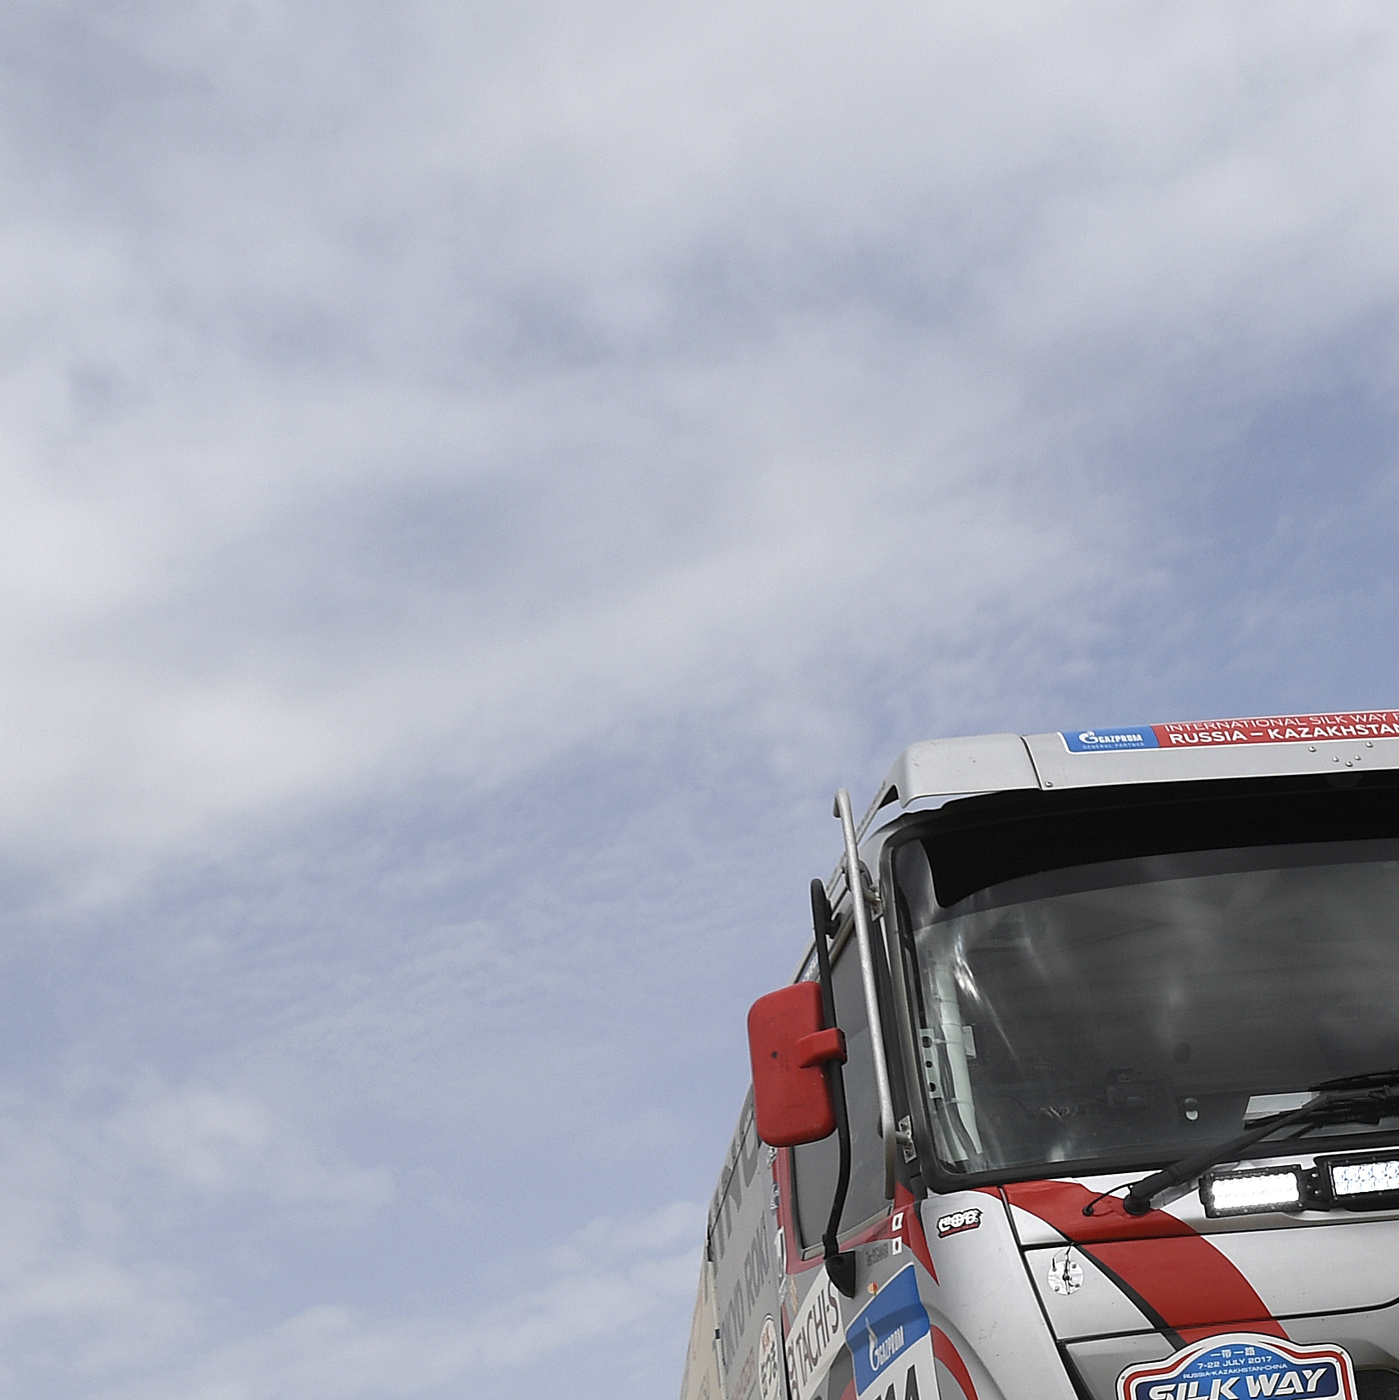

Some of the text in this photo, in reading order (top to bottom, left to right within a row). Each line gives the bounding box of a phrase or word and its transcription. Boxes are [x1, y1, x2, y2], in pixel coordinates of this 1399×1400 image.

[1164, 716, 1307, 732] INTERNATIONAL
[1311, 715, 1348, 726] SILK
[1350, 712, 1389, 723] WAY
[1099, 732, 1143, 744] GAZPROM
[1169, 730, 1247, 744] RUSSIA
[1197, 1355, 1272, 1370] 7-22 JULY 2017
[1244, 1367, 1329, 1399] WAY
